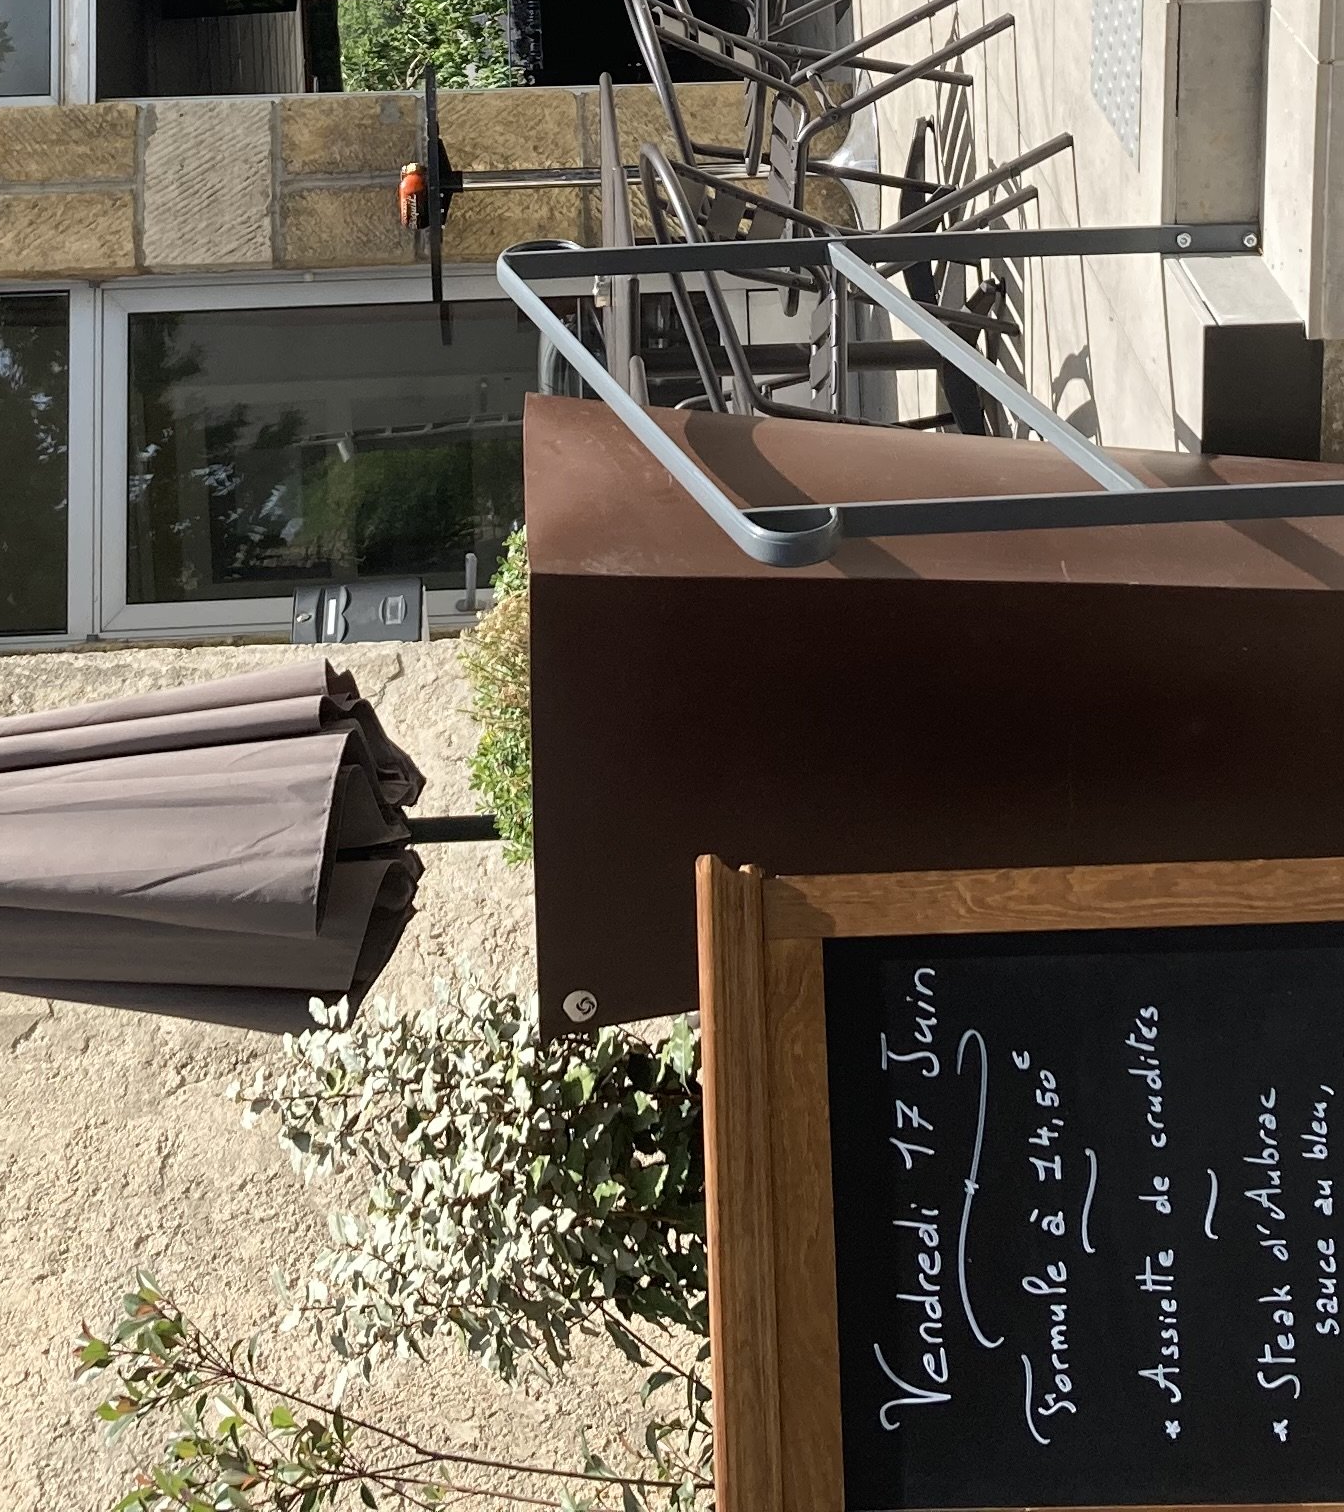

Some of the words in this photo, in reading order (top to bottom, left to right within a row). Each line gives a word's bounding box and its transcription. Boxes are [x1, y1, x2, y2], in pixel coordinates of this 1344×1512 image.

[880, 967, 940, 1078] Juin
[1125, 1005, 1167, 1148] crudités
[889, 1099, 935, 1170] 17
[1243, 1087, 1290, 1261] d'Aubrac
[1300, 1084, 1335, 1159] bleu,
[1030, 1209, 1065, 1236] à
[1138, 1176, 1172, 1213] de
[1313, 1179, 1334, 1216] au
[874, 1203, 951, 1430] Vendredi
[1135, 1249, 1182, 1403] Assiette
[1257, 1285, 1300, 1400] Steak
[1315, 1238, 1340, 1336] sauce
[1021, 1261, 1076, 1444] Formule
